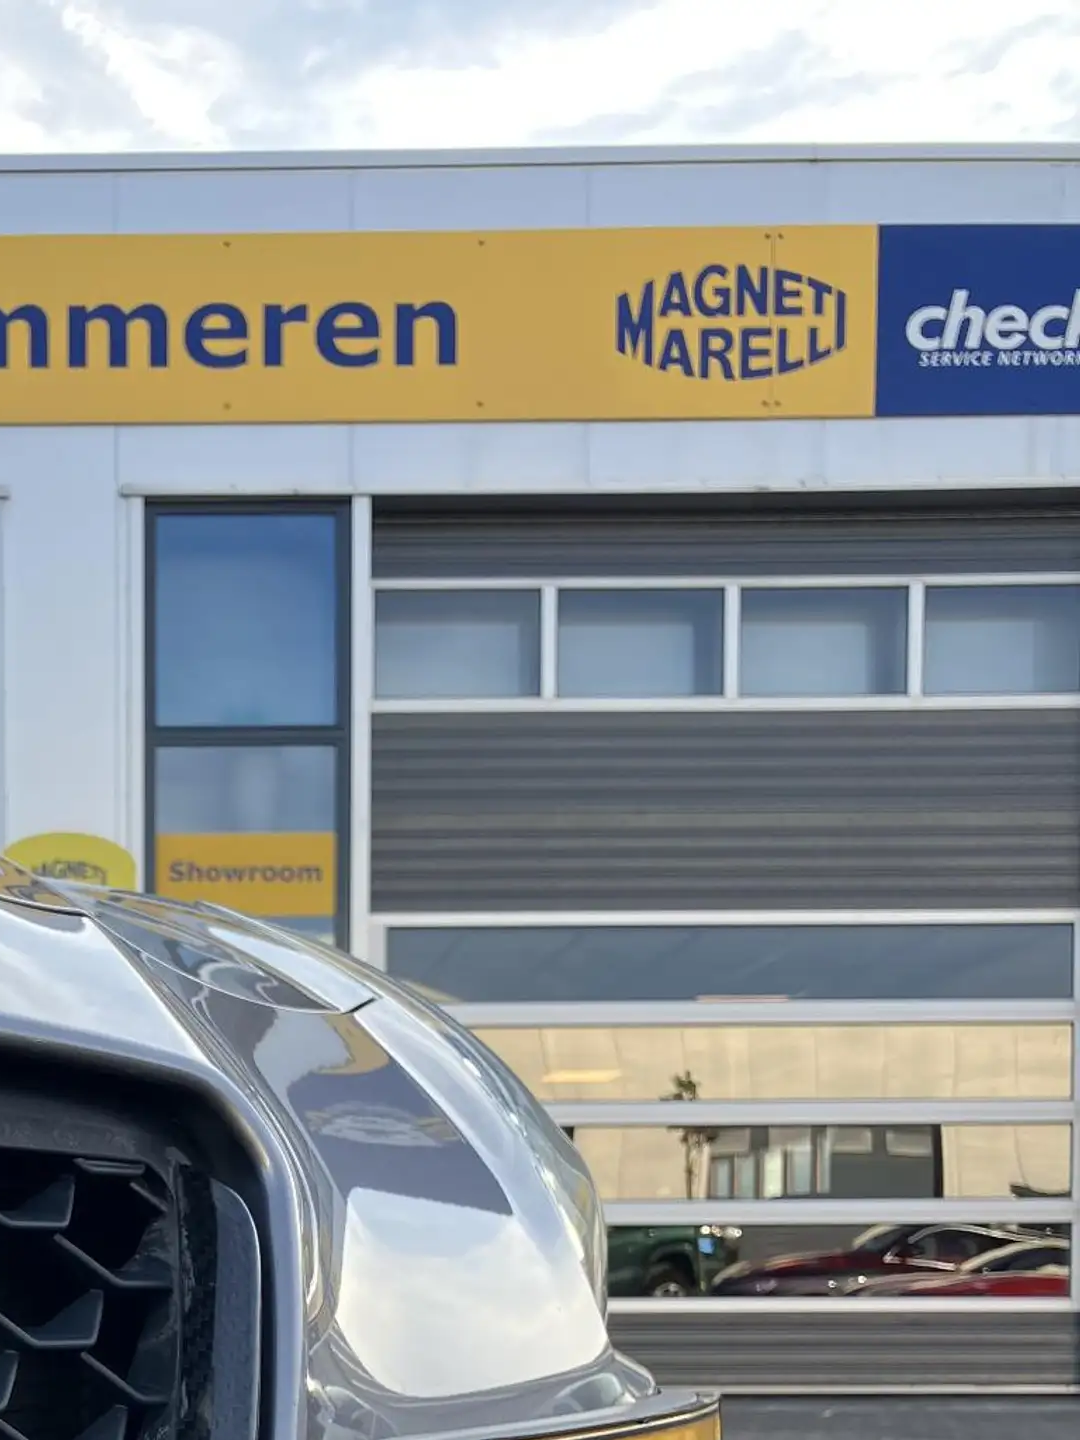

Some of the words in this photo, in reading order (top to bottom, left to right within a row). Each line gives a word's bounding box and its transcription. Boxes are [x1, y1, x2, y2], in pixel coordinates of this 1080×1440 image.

[615, 264, 847, 335] MAGNETI
[615, 312, 847, 381] MARELLI
[918, 350, 993, 367] SERVICE
[168, 859, 324, 884] Showroom
